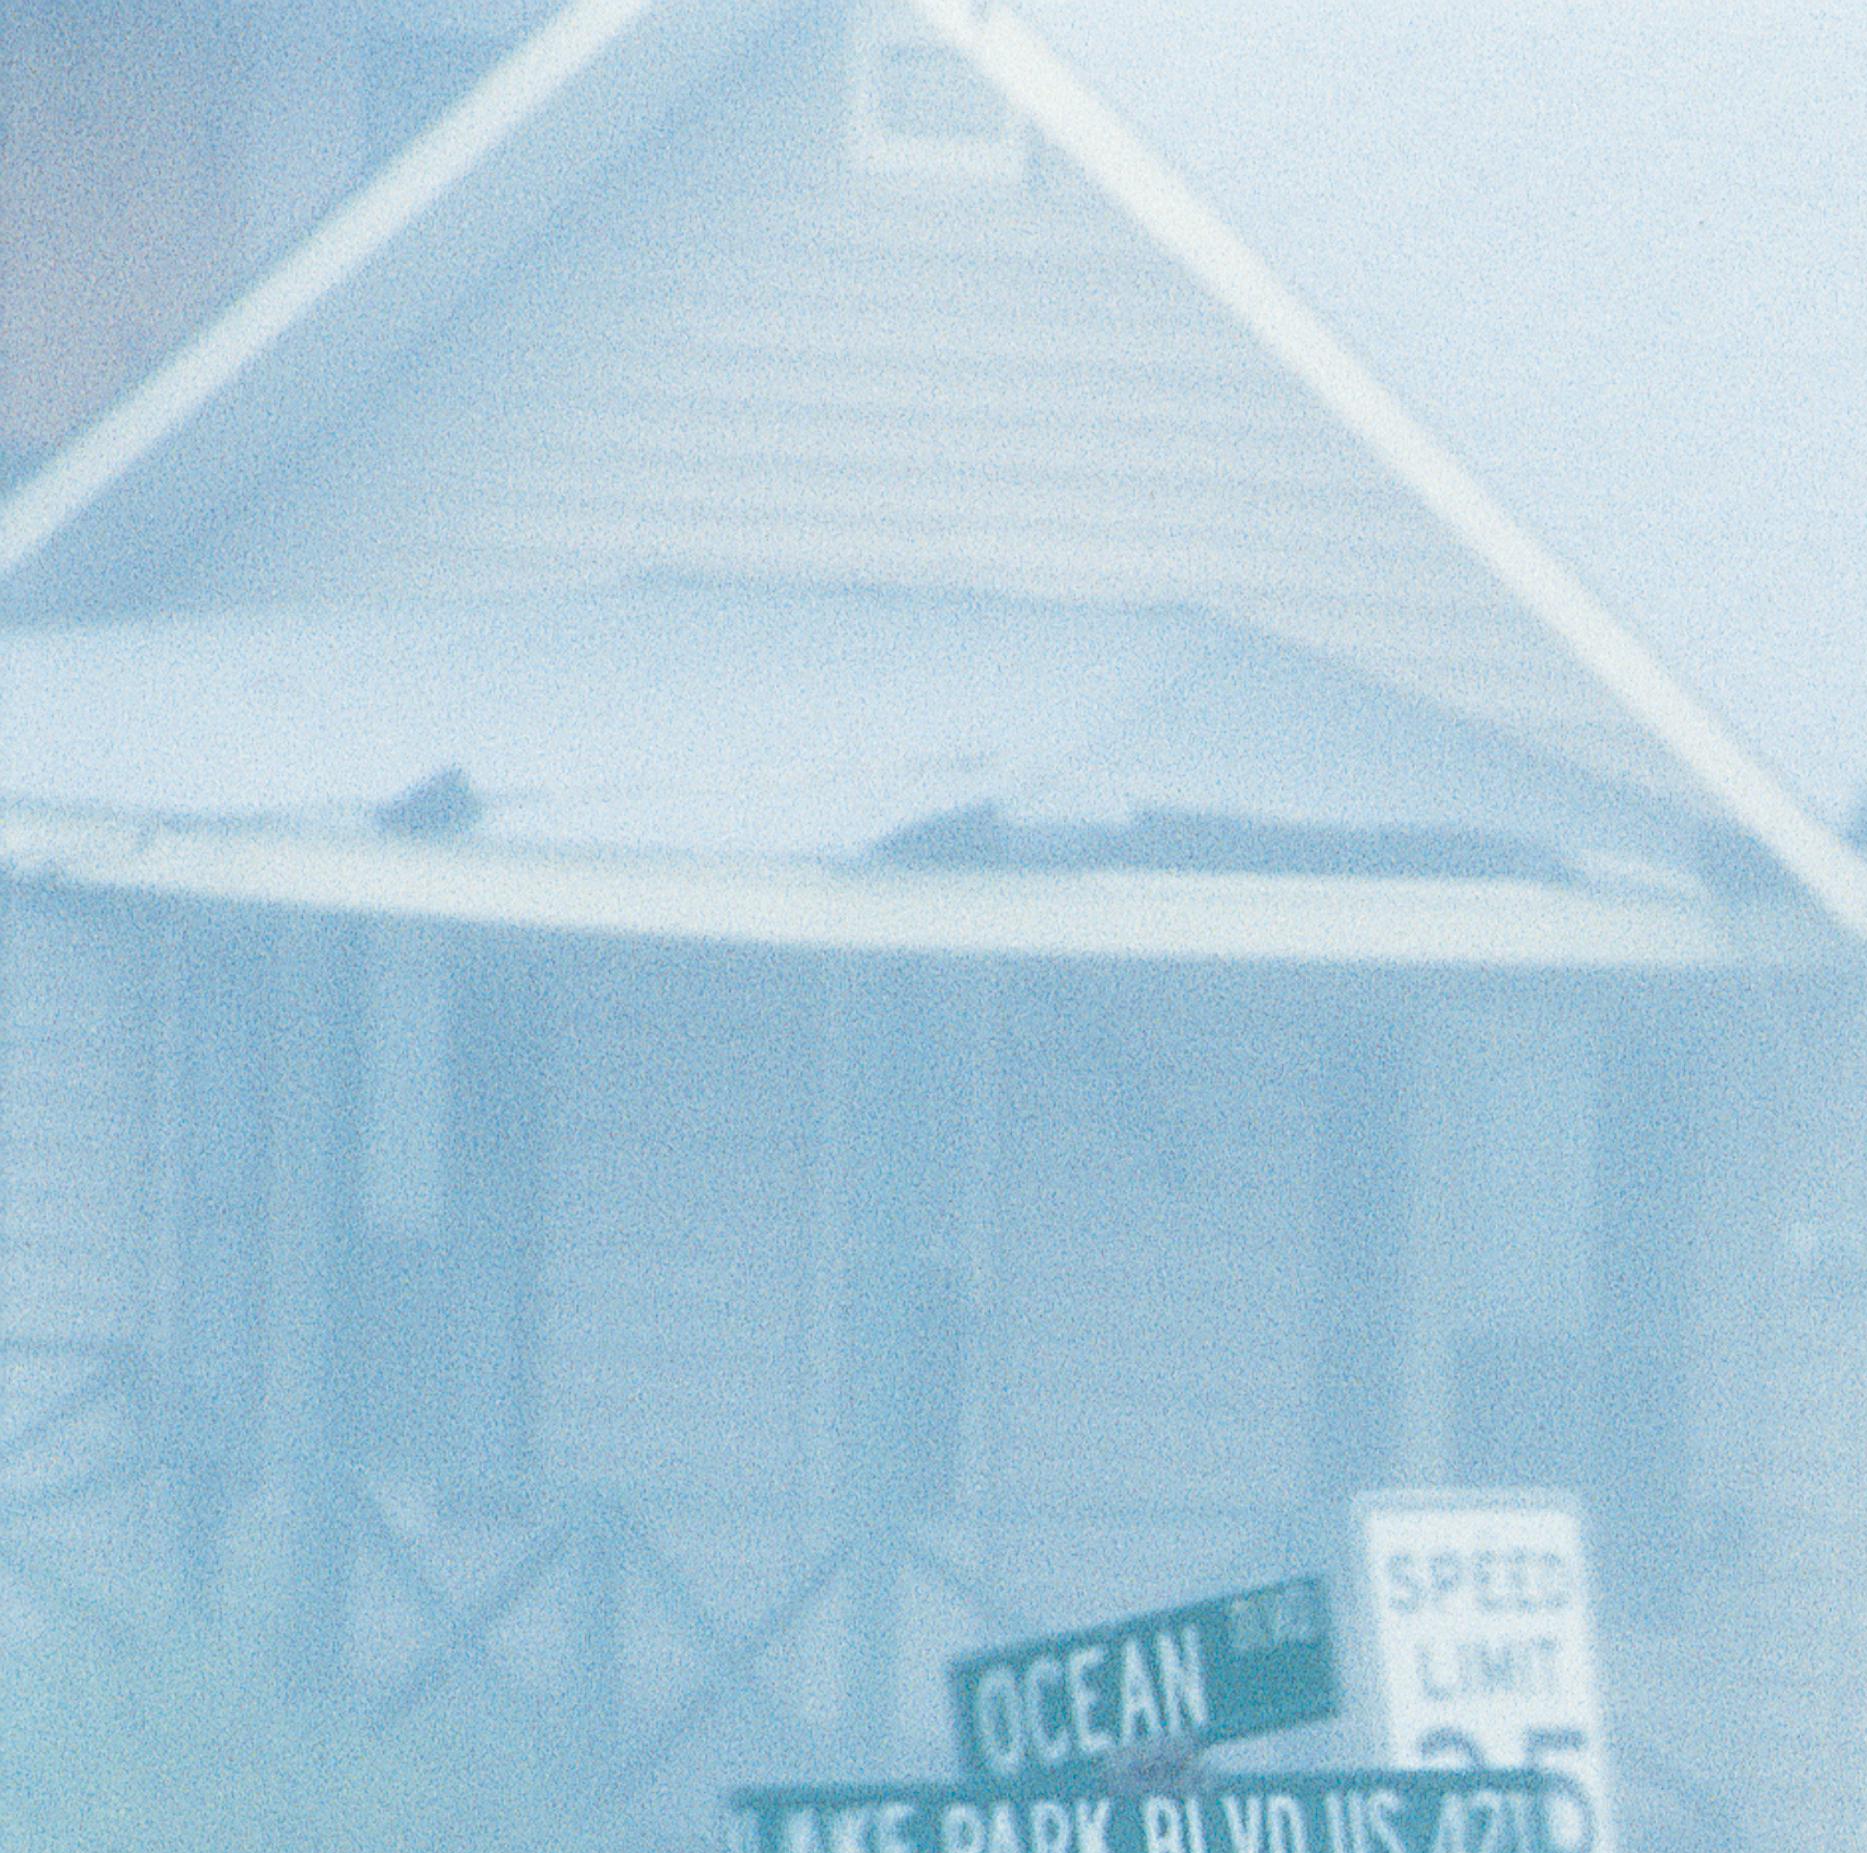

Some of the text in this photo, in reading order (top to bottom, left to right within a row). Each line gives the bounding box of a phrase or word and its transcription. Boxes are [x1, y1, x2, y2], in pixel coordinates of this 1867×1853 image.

[1386, 1547, 1568, 1613] SPEED
[975, 1624, 1207, 1773] OCEAN
[1415, 1636, 1558, 1701] LIMIT
